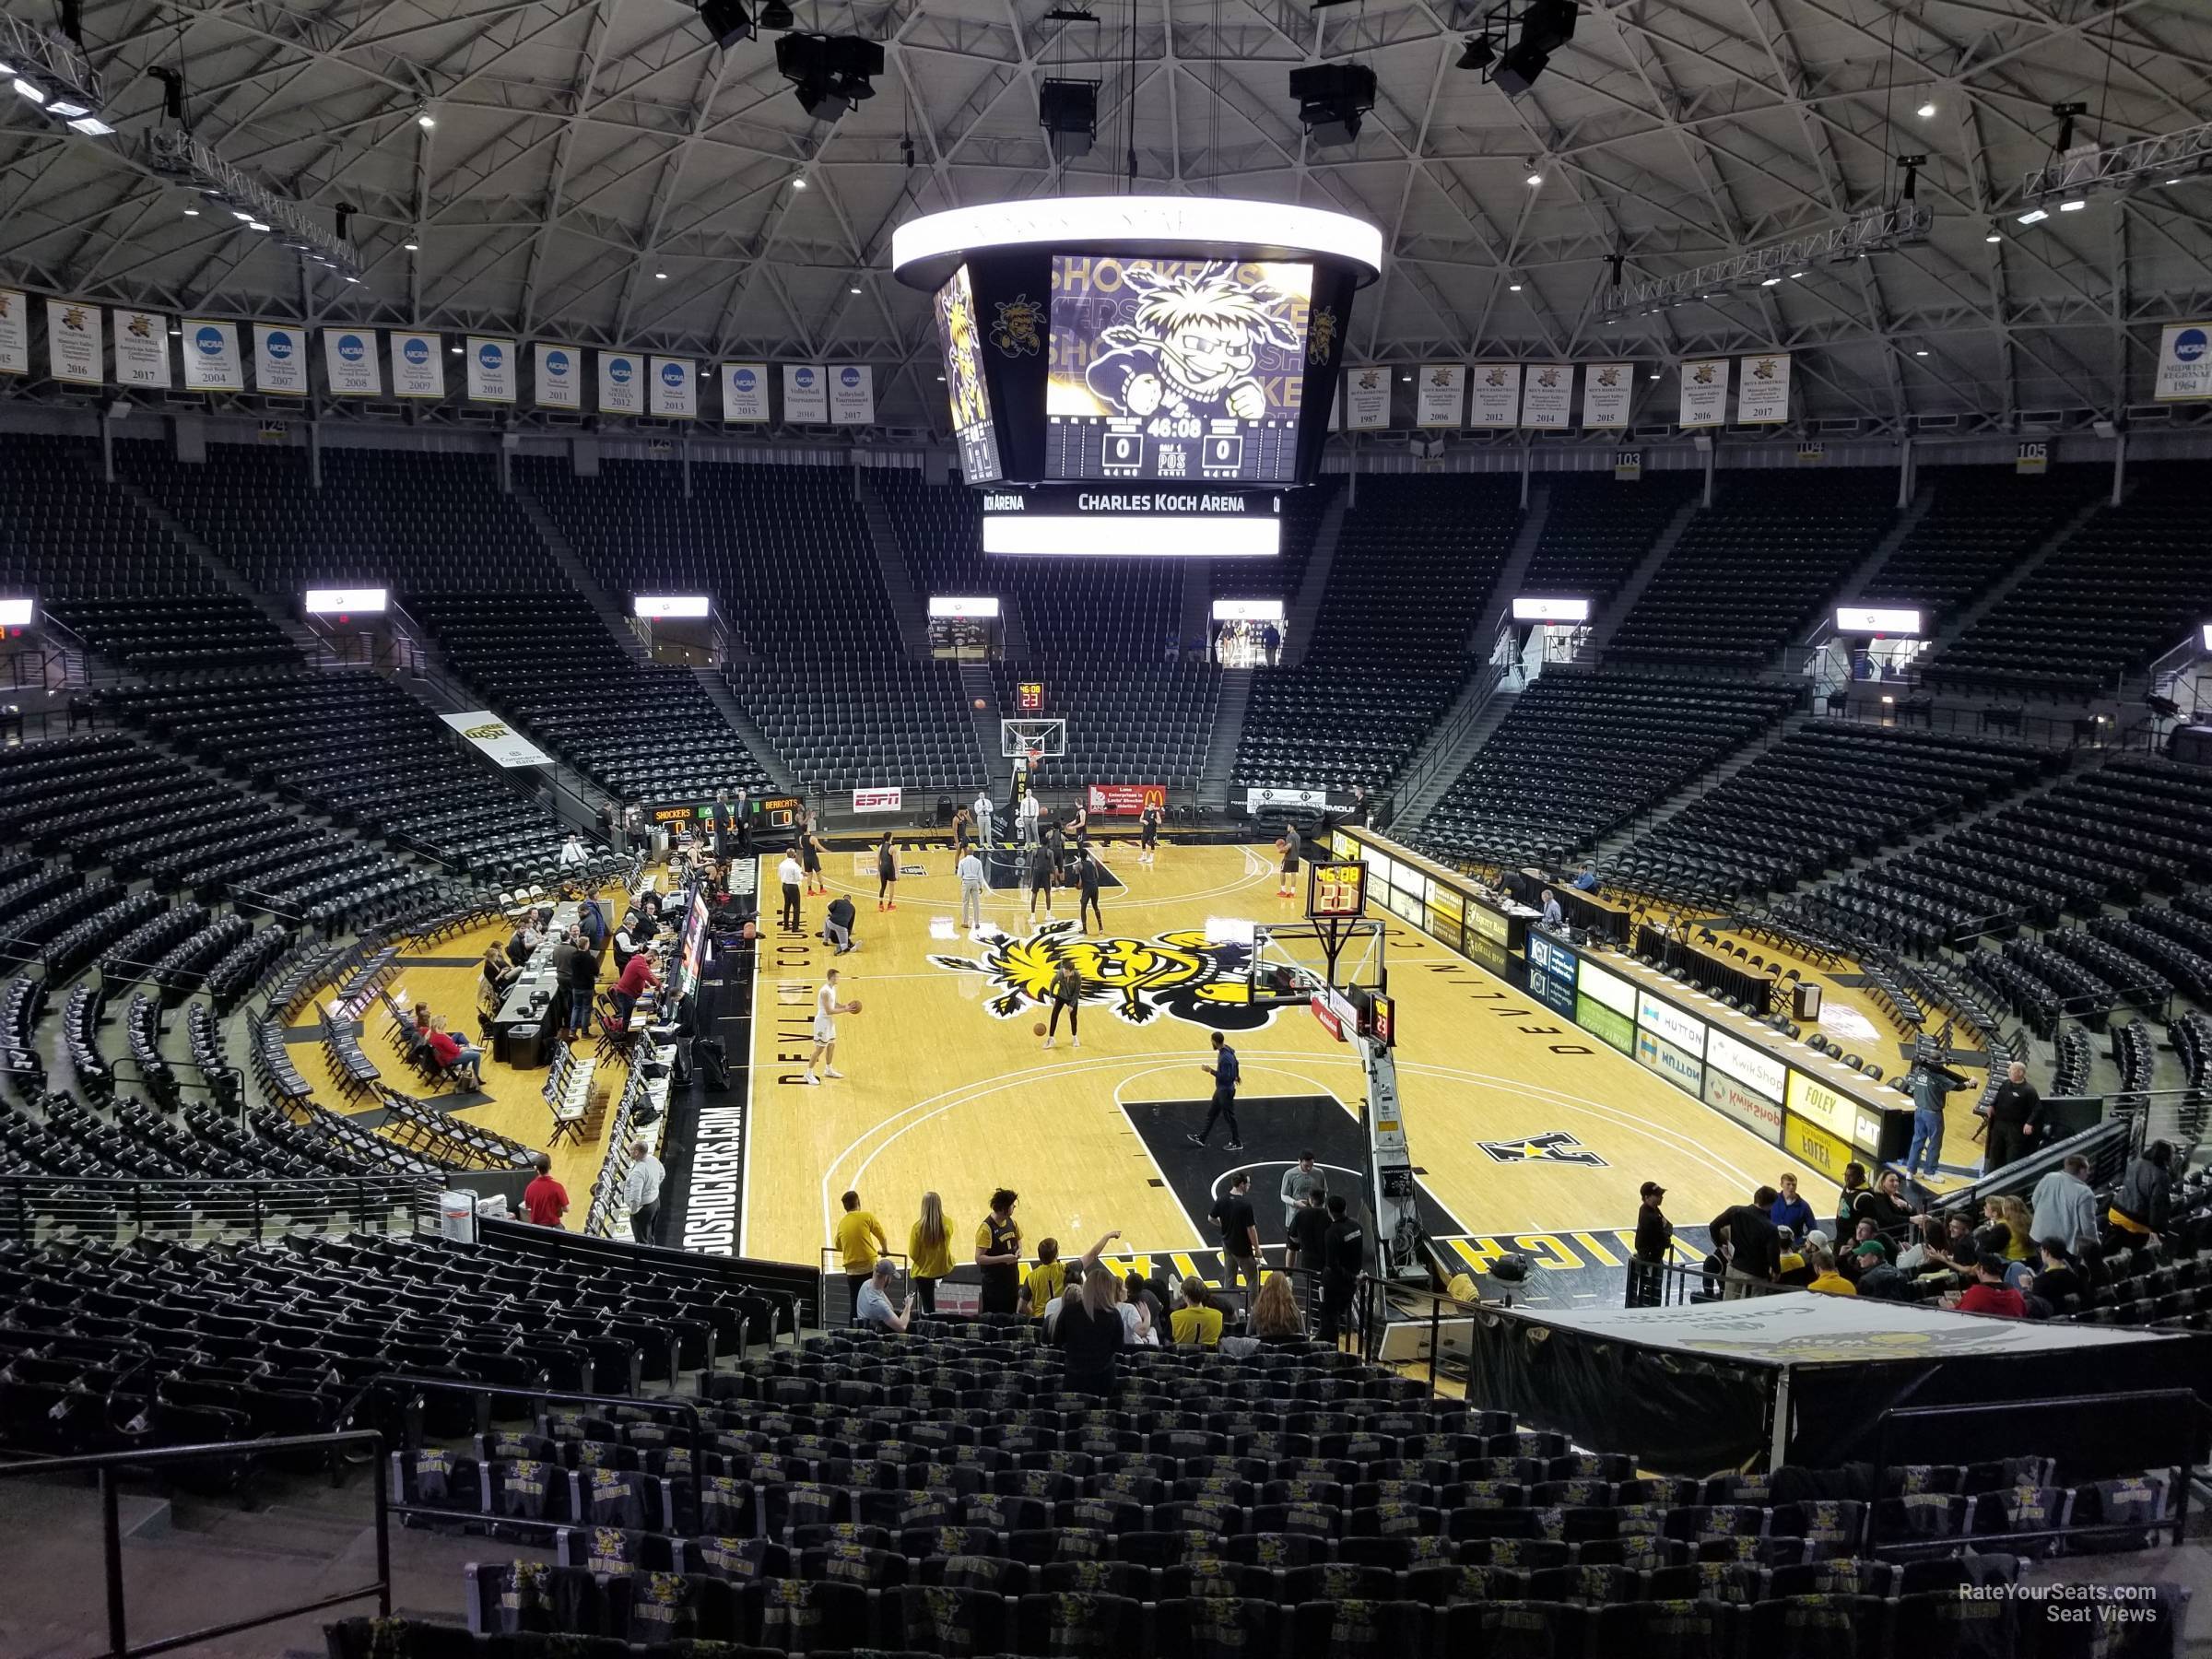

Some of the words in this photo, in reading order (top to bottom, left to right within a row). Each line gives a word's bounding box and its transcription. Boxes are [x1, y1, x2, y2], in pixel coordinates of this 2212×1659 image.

[199, 340, 223, 348] NCAA
[269, 344, 292, 353] NCAA
[406, 350, 429, 359] NCAA
[481, 356, 502, 364] NCAA
[66, 363, 88, 375] 2016
[548, 361, 569, 371] NCAA
[132, 370, 155, 381] 2017
[202, 373, 227, 383] 2004
[611, 369, 632, 377] NCAA
[664, 373, 685, 382] NCAA
[271, 376, 293, 386] 2007
[345, 379, 368, 388] 2008
[796, 375, 813, 383] NCAA
[408, 380, 430, 391] 2009
[482, 384, 504, 394] 2010
[548, 391, 569, 401] 2011
[611, 397, 631, 407] 2012
[664, 401, 685, 411] 2013
[736, 406, 758, 416] 2015
[843, 410, 862, 419] 2017
[1693, 412, 1712, 420] 2016
[1753, 407, 1772, 417] 2017
[1360, 415, 1377, 424] 1987
[1430, 413, 1449, 421] 2006
[1485, 414, 1503, 422] 2012
[1596, 414, 1615, 422] 2015
[1147, 418, 1202, 438] 46:08
[1116, 438, 1130, 458] 0
[1216, 440, 1230, 460] 0
[2019, 443, 2046, 458] 105
[1159, 454, 1186, 469] POS
[1617, 453, 1641, 465] 103
[994, 494, 1024, 510] ARENA
[1078, 493, 1150, 512] CHARLES
[1155, 494, 1197, 512] KOCH
[1200, 495, 1244, 512] ARENA
[1019, 685, 1041, 693] 46:08
[1022, 693, 1038, 707] 23
[766, 799, 798, 810] BEARCATS
[855, 793, 900, 806] ESPN
[655, 809, 691, 819] SHOCKERS
[783, 811, 791, 824] 0
[1317, 867, 1359, 882] 46:08
[1321, 885, 1352, 911] 23
[1377, 1015, 1386, 1034] 23
[1665, 1017, 1702, 1046] HUTTON
[1805, 1086, 1837, 1115] FOLEY
[683, 1106, 741, 1257] GOSHOCKERS.COM
